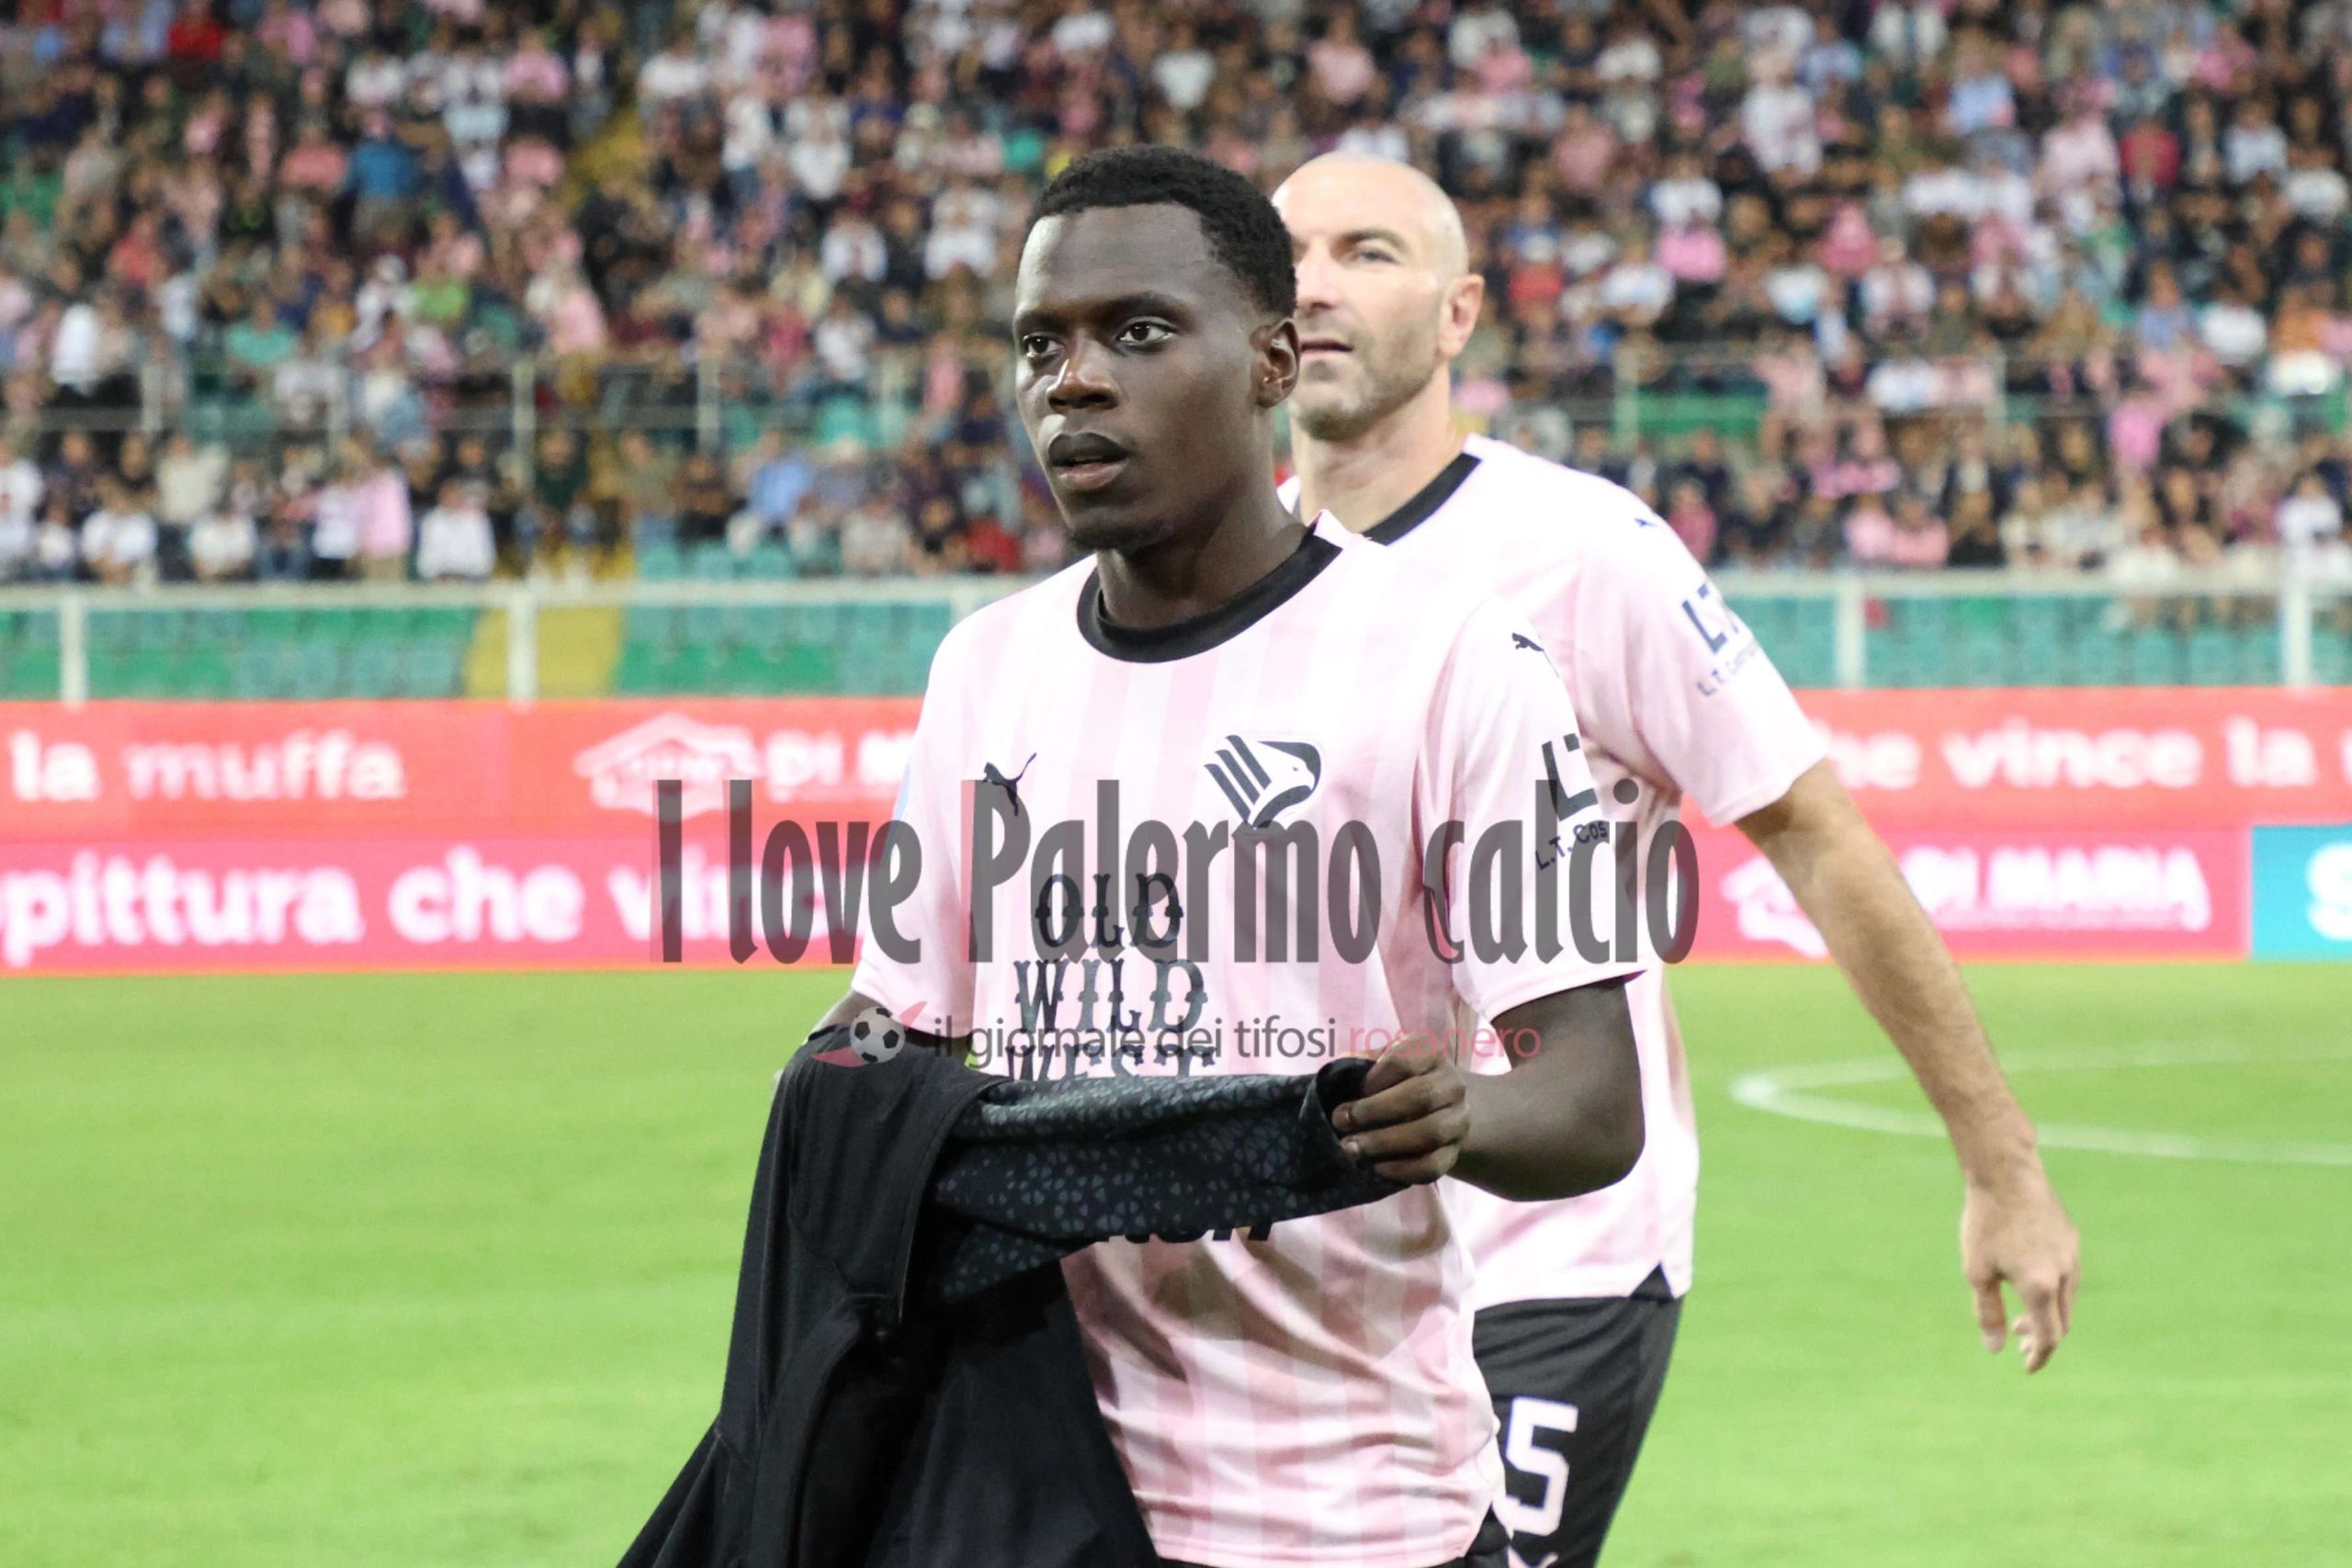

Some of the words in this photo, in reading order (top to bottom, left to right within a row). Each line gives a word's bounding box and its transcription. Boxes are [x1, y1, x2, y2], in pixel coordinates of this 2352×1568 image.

[11, 729, 98, 800] la
[127, 729, 404, 798] muffa
[1942, 716, 2203, 788] vince
[2223, 715, 2315, 786] la
[387, 843, 585, 942] che
[1035, 873, 1184, 948] OLD
[1987, 845, 2212, 931] MARIA
[1013, 958, 1208, 1034] WILD
[1506, 1395, 1579, 1537] 5
